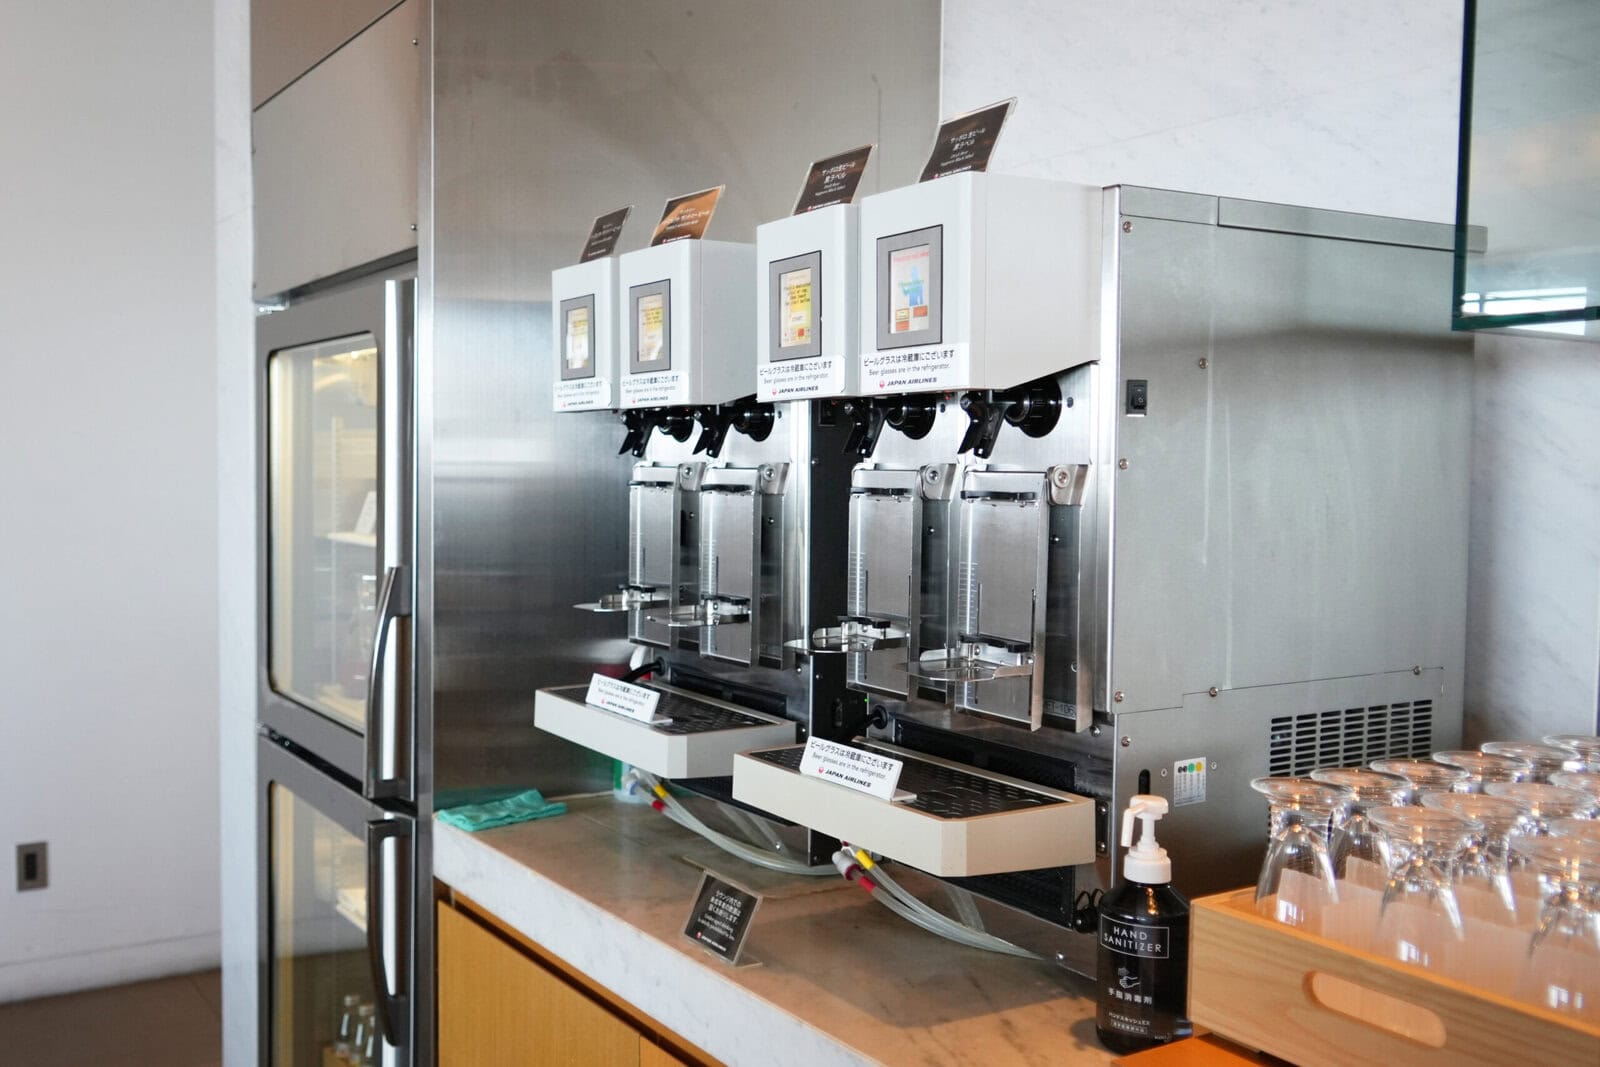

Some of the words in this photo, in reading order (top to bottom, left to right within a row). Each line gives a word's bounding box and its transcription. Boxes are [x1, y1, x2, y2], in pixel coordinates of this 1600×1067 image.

[863, 349, 953, 366] ビールグラスは冷蔵庫にございます
[825, 768, 843, 778] JAPAN
[844, 774, 871, 788] AIRLINES
[1103, 932, 1162, 953] SANITIZER
[1113, 926, 1148, 941] HAND
[1108, 987, 1153, 1005] 手指消毒剤
